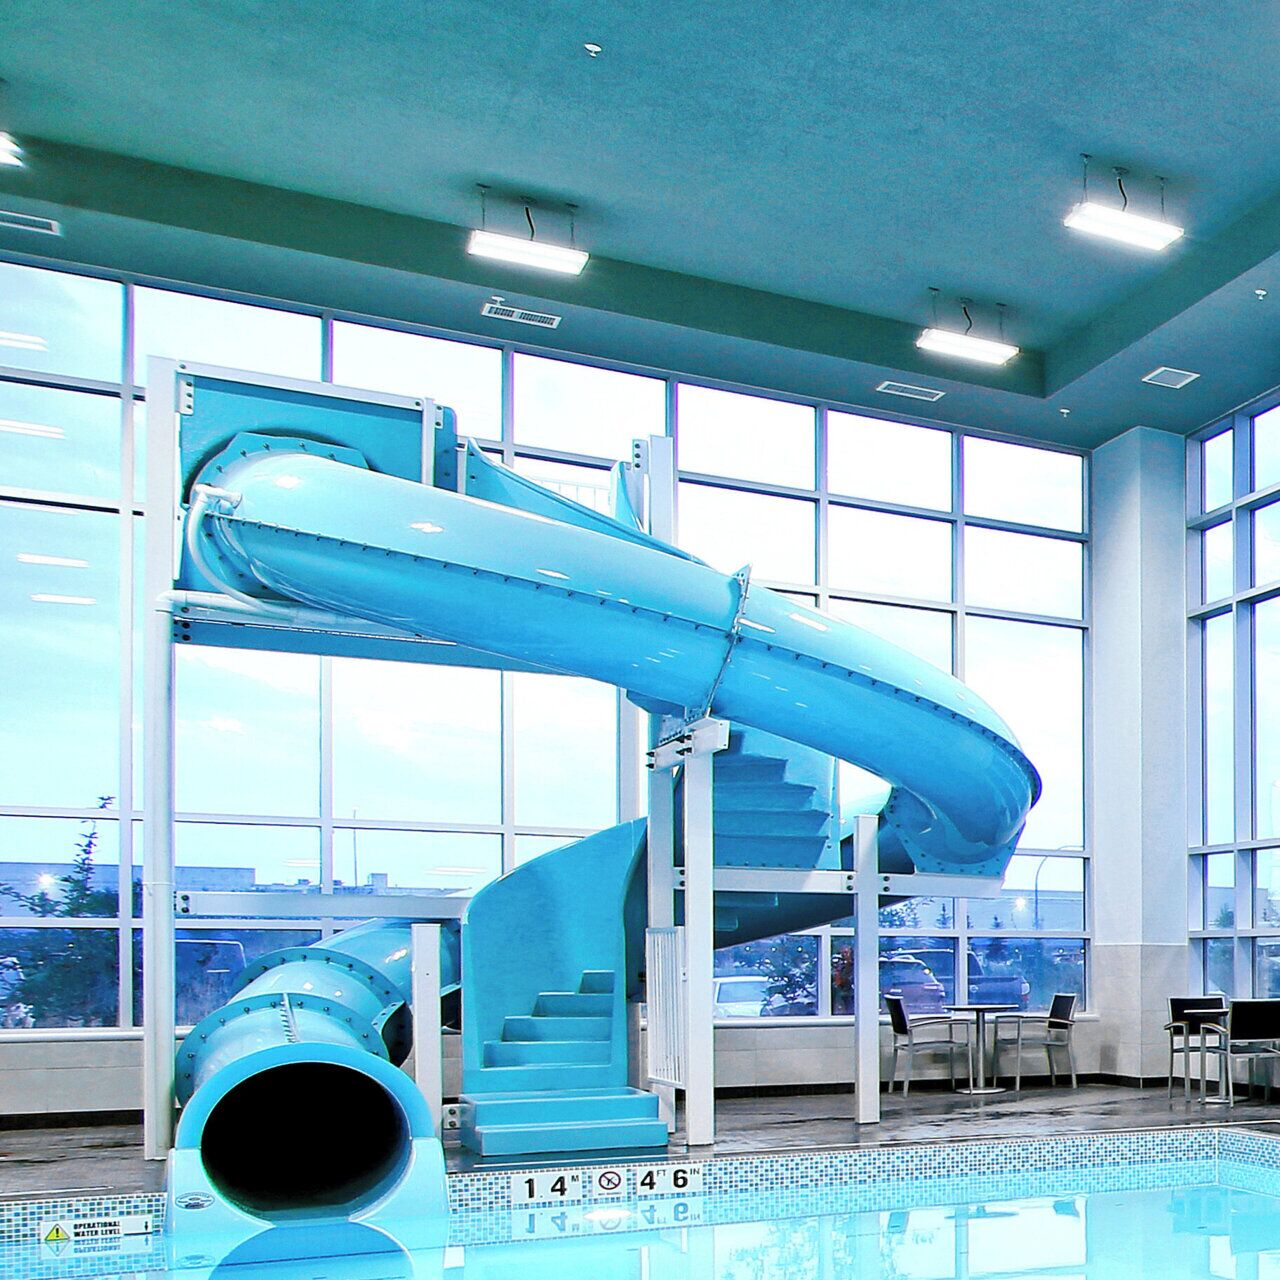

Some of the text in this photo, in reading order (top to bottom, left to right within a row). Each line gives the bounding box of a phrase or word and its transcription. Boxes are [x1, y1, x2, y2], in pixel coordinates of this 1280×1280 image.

[571, 1175, 580, 1183] M
[640, 1170, 656, 1190] 4
[656, 1169, 667, 1177] FT
[673, 1169, 689, 1189] 6
[689, 1167, 700, 1176] IN
[74, 1230, 99, 1238] WATER
